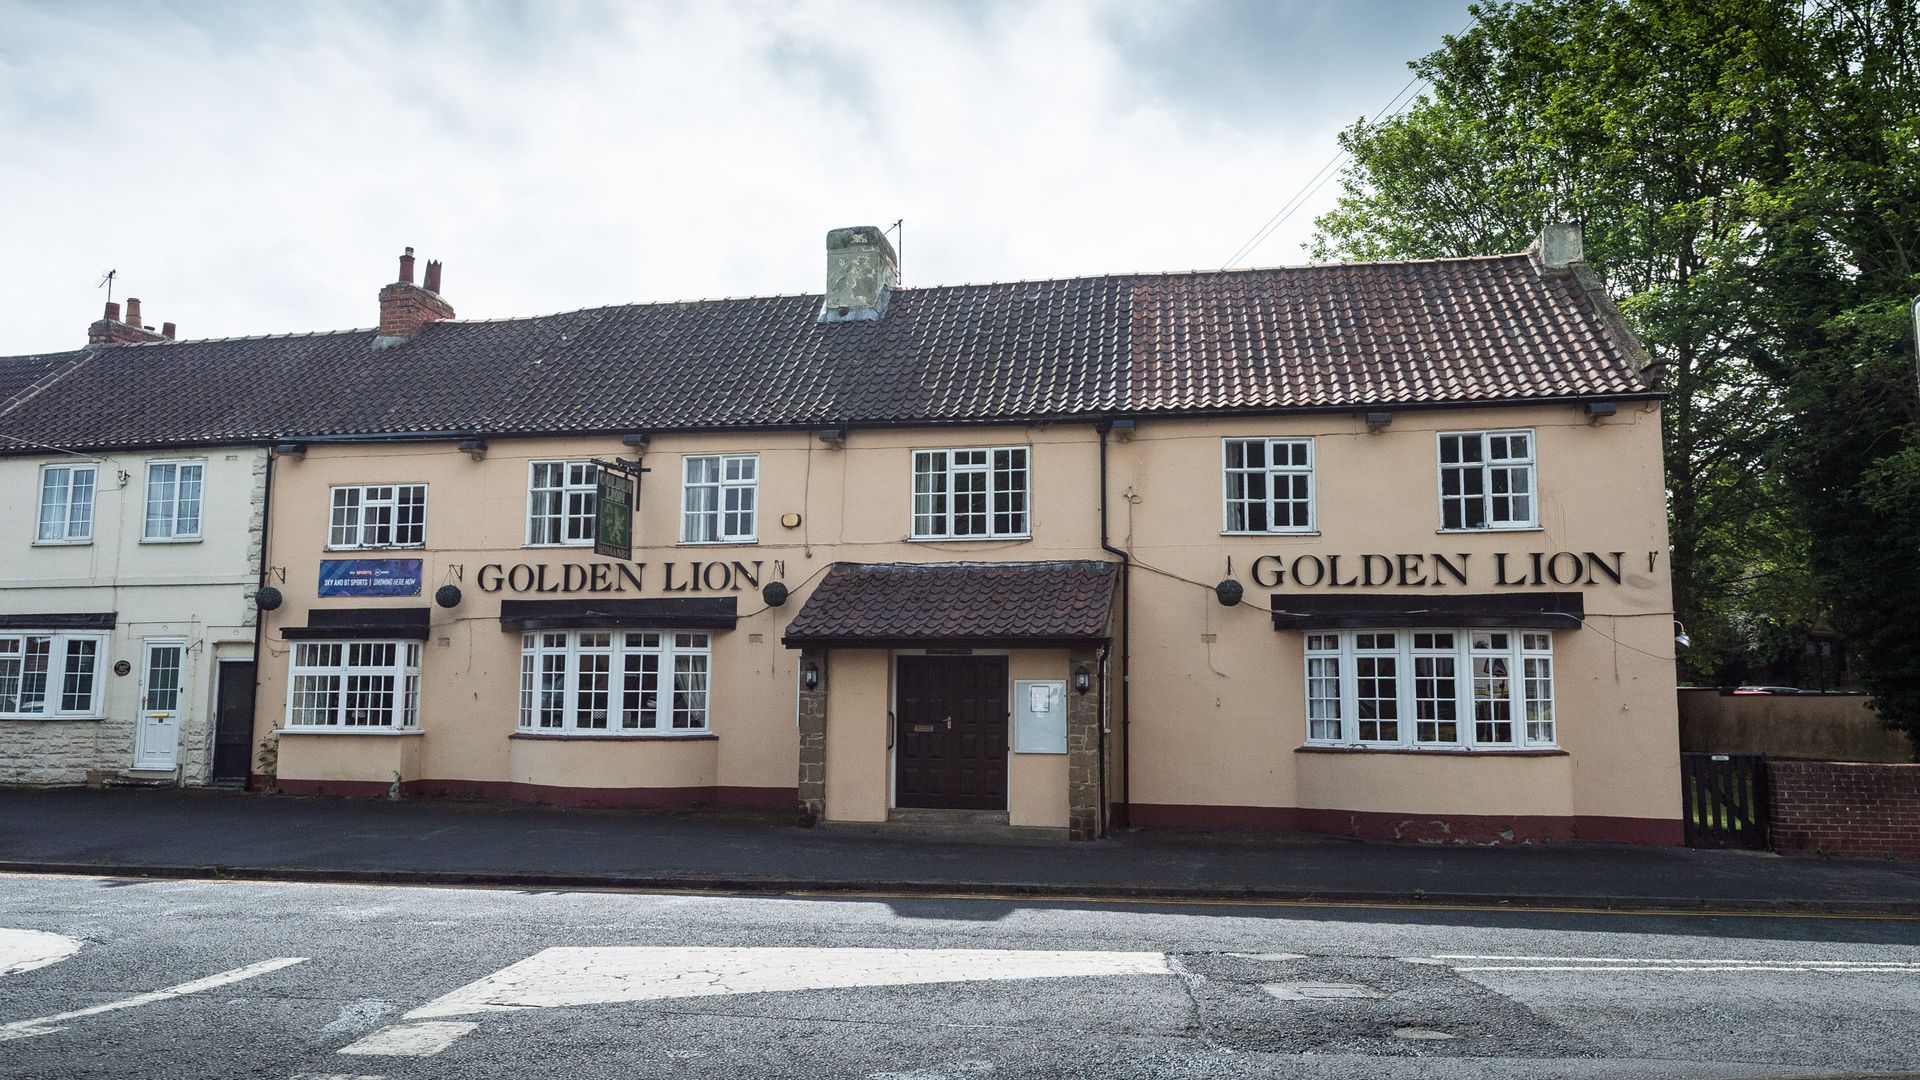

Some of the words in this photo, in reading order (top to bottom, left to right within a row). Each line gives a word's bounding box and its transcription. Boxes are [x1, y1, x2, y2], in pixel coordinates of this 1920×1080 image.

[477, 562, 647, 592] GOLDEN
[662, 560, 763, 591] LION
[1251, 552, 1472, 587] GOLDEN
[1494, 551, 1627, 587] LION
